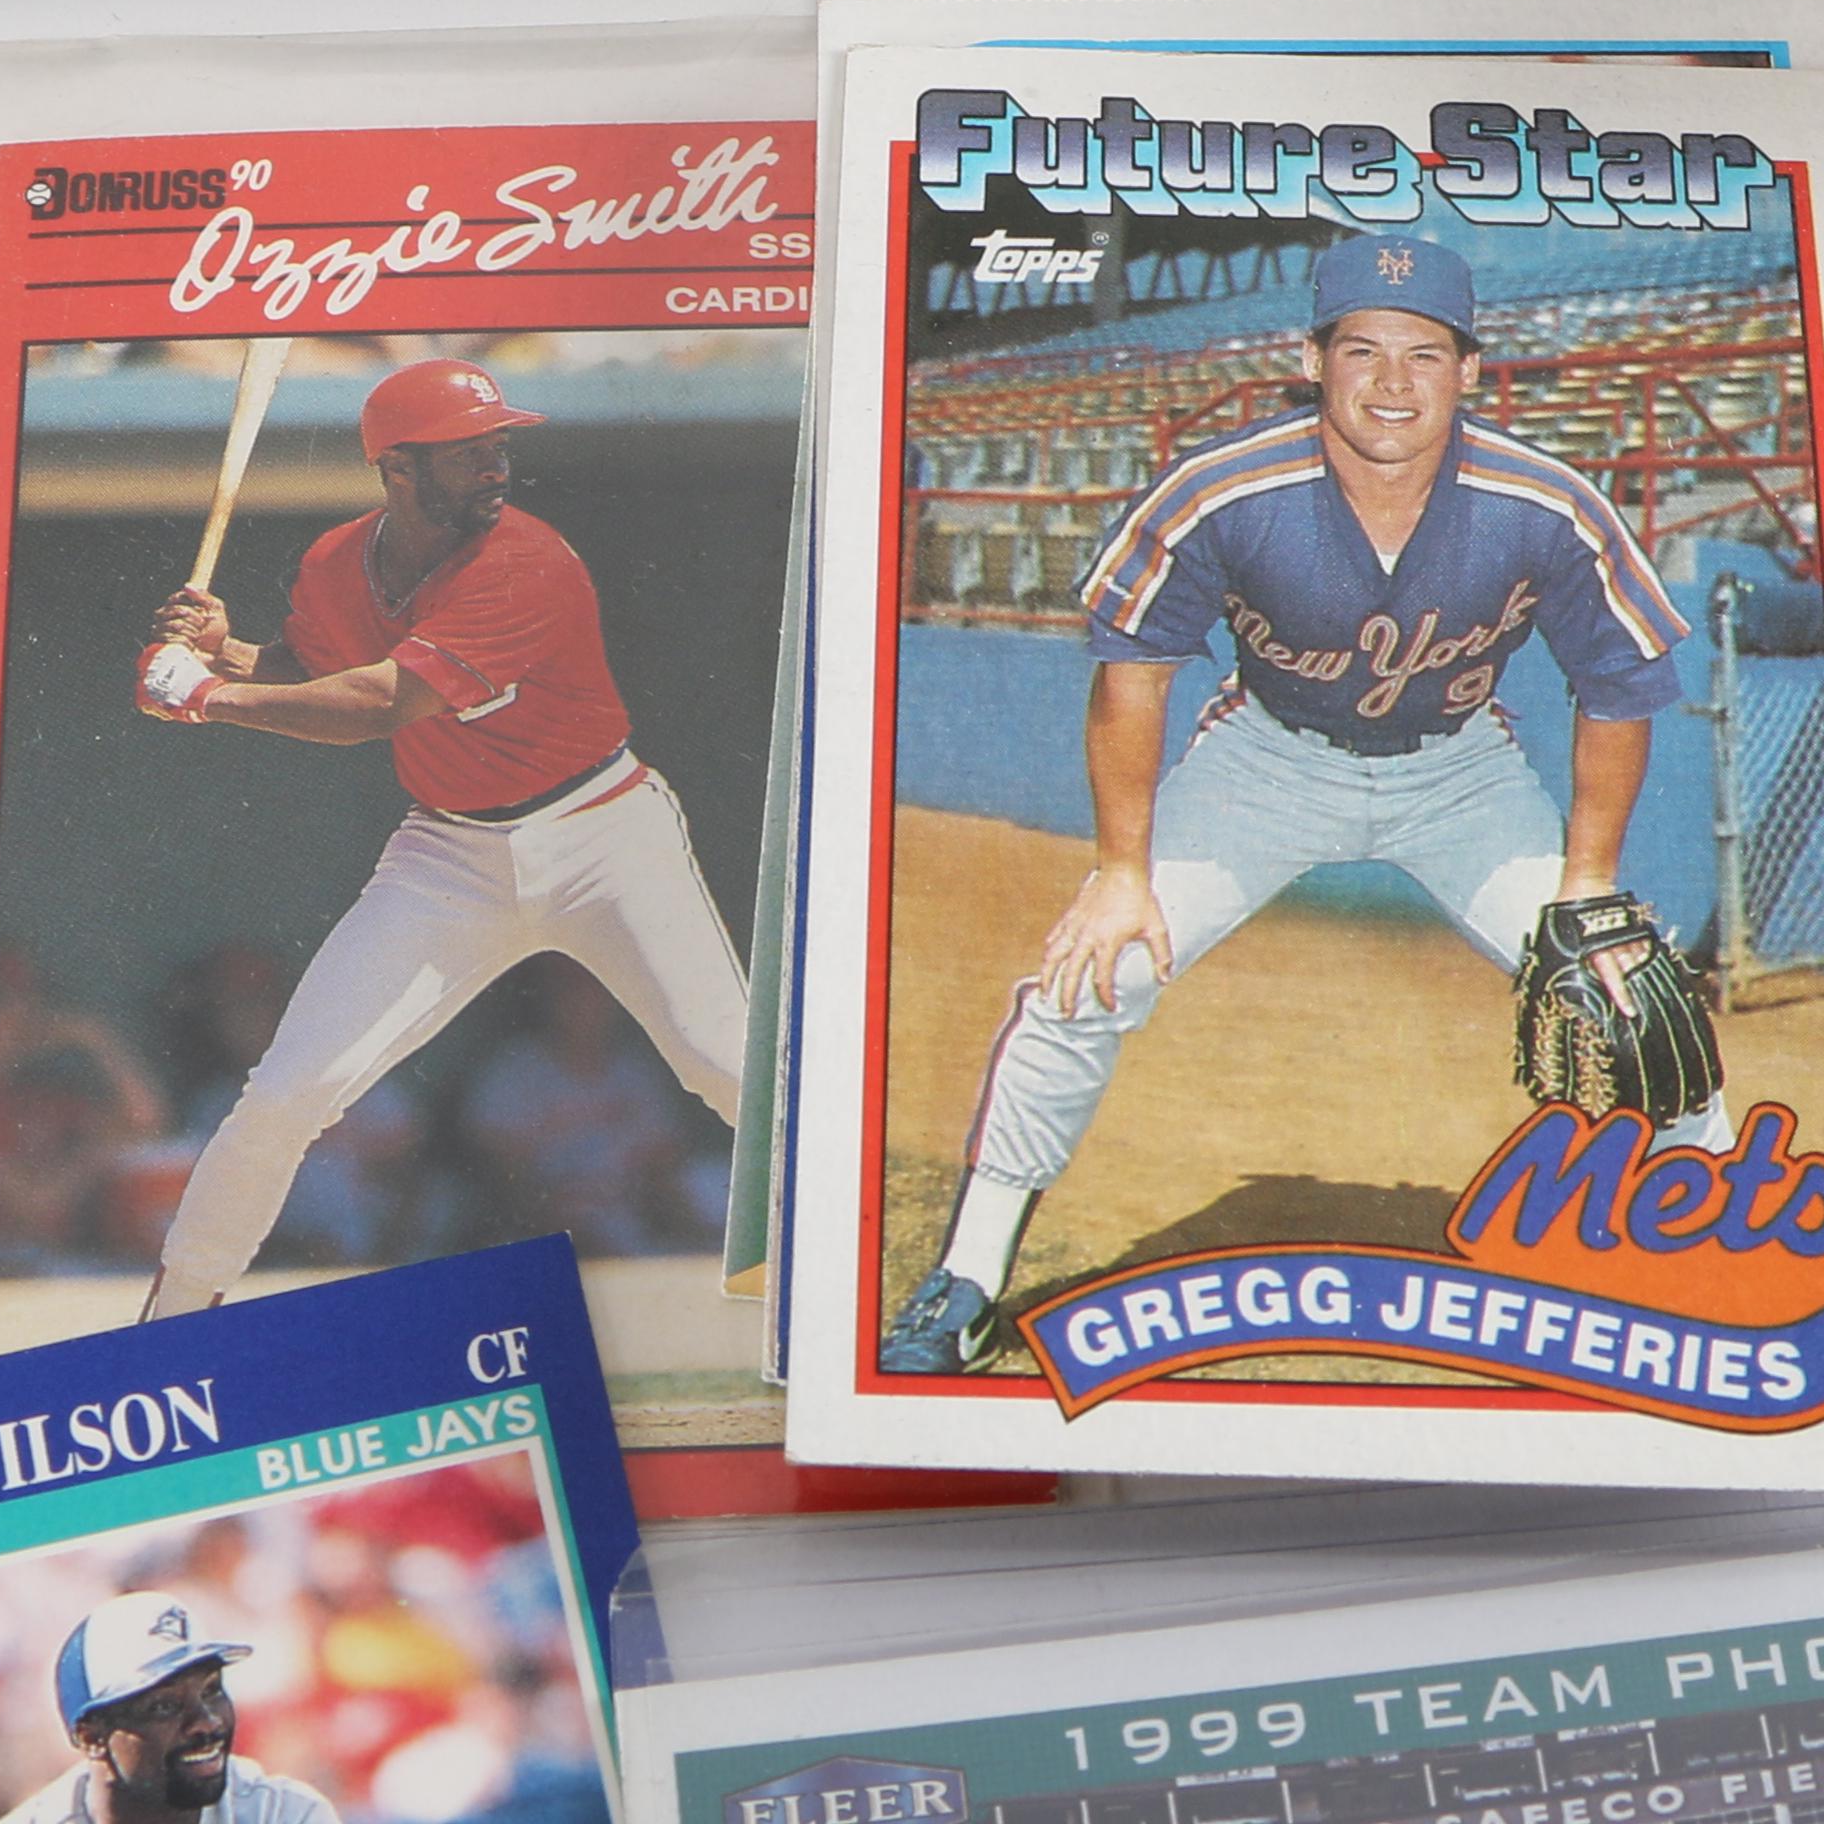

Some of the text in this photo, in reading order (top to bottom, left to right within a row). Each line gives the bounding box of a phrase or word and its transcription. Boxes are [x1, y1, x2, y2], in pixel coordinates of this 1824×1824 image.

[26, 159, 273, 221] DONRUSS 90
[916, 89, 1769, 222] Future Star
[170, 135, 780, 320] Ozzie Smith
[748, 233, 811, 259] SS
[665, 286, 808, 314] CARDI
[1222, 578, 1540, 719] New York
[1443, 663, 1494, 716] 9
[466, 1326, 530, 1384] CF
[1066, 1263, 1807, 1403] GREGG JEFFERIES
[257, 1393, 537, 1492] BLUE JAYS
[1065, 1703, 1307, 1772] 1999
[1354, 1664, 1613, 1738] TEAM
[738, 1779, 955, 1824] FLEER
